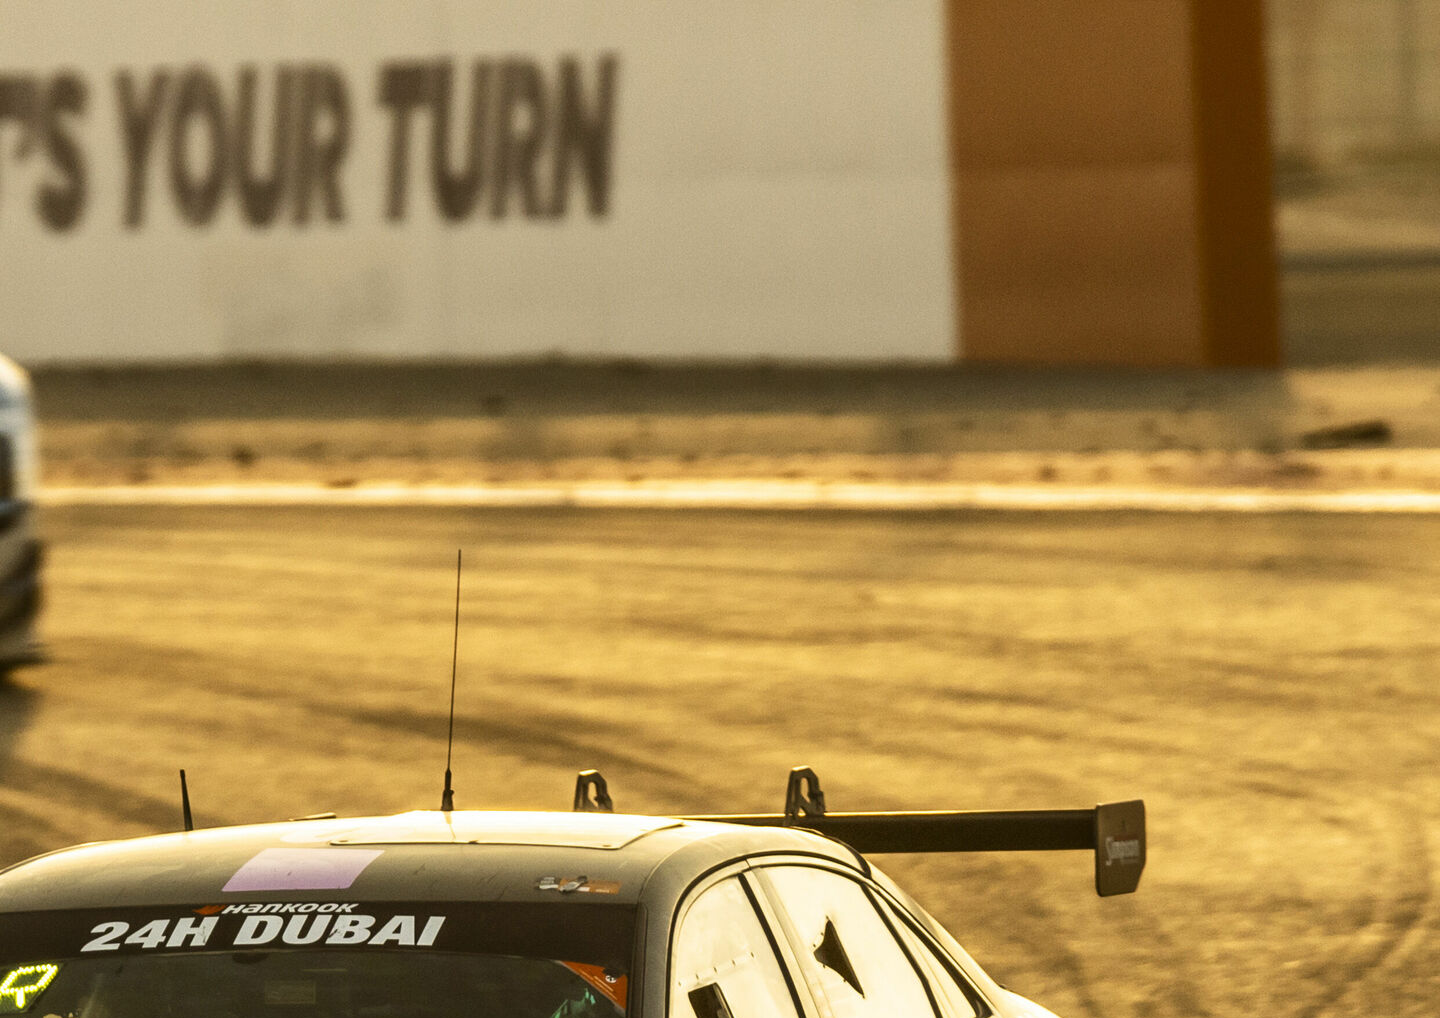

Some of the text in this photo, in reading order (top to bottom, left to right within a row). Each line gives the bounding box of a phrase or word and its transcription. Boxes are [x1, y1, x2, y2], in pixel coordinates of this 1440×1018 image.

[114, 62, 354, 230] YOUR
[377, 54, 618, 224] TURN
[80, 914, 446, 952] 24H DUBAI
